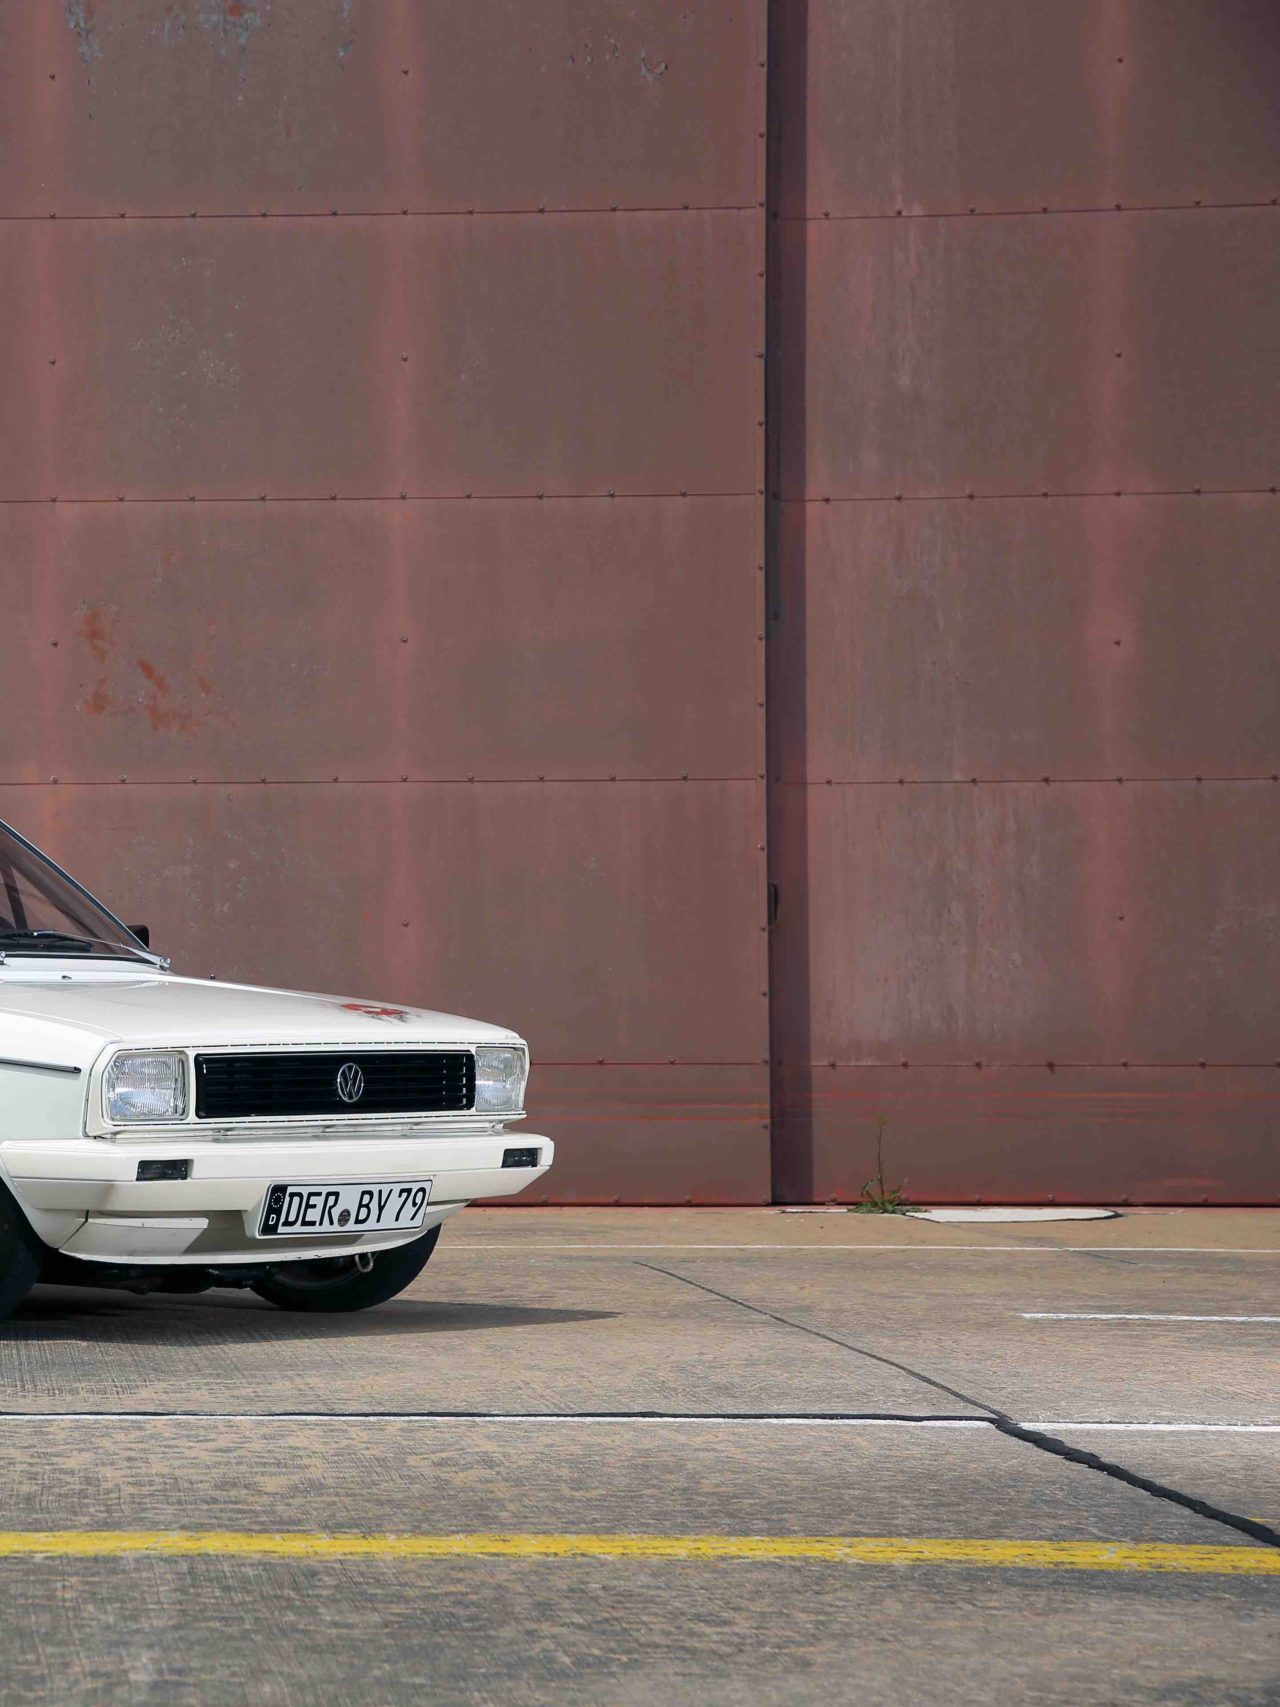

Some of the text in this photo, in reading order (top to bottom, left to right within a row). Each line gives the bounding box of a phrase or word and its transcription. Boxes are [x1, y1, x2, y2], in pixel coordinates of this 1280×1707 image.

[269, 1214, 277, 1225] D
[281, 1190, 341, 1228] DER
[354, 1188, 393, 1225] BY
[395, 1186, 427, 1222] 79
